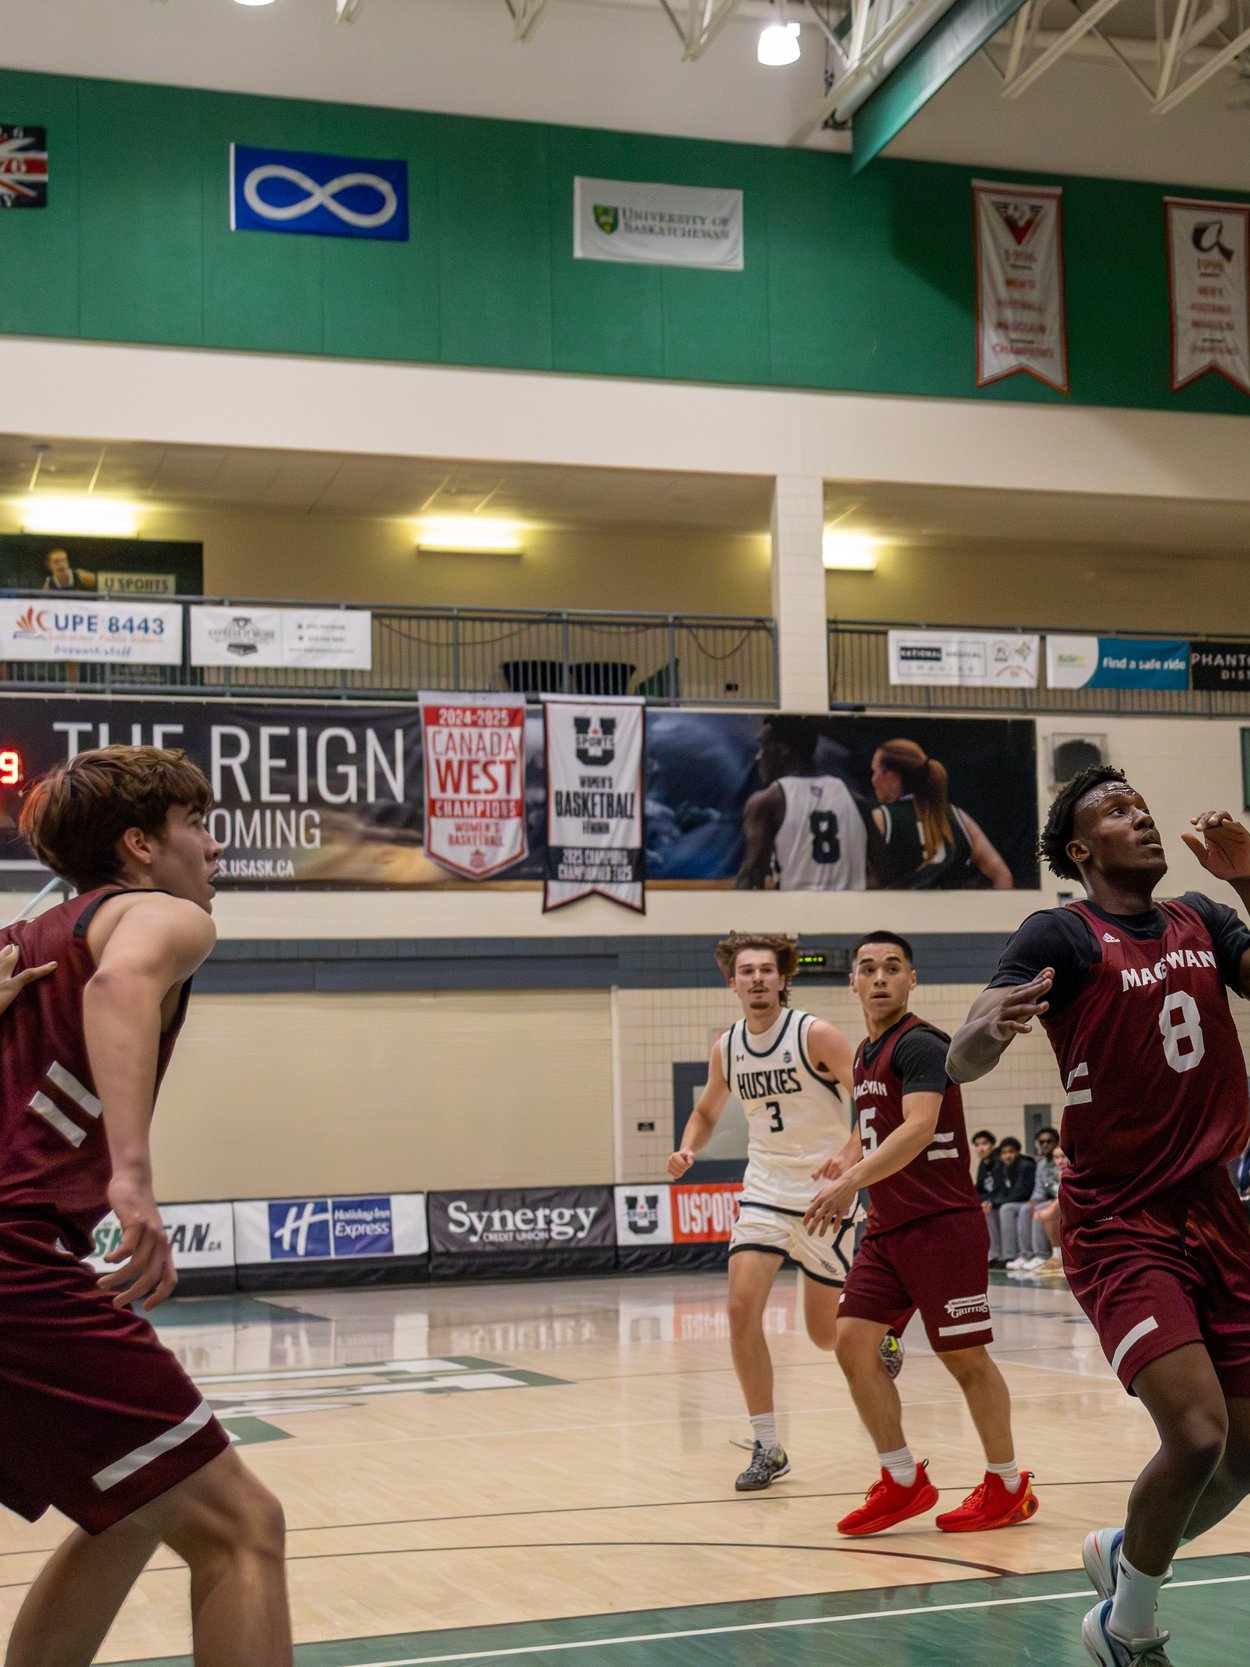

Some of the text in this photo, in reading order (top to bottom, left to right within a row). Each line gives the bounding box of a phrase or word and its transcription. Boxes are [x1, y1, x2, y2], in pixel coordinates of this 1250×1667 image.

[622, 207, 730, 227] UNIVERSITY OF
[623, 222, 729, 239] SASKATCHEWAN
[118, 579, 169, 592] SPORTS
[107, 616, 165, 635] 8443
[1103, 658, 1127, 670] Find
[1138, 658, 1162, 670] safe
[1163, 658, 1186, 670] ride
[439, 709, 509, 725] 2024-2025
[432, 730, 518, 757] CANADA
[211, 726, 404, 804] REIGN
[435, 759, 516, 795] WEST
[435, 801, 516, 817] CHAMPIONS
[555, 791, 635, 819] BASKETBALL
[204, 808, 322, 849] OMING
[809, 810, 840, 864] 8
[215, 858, 295, 878] S.USASK.CA
[1159, 990, 1206, 1073] 8
[737, 1068, 802, 1100] HUSKIES
[766, 1102, 785, 1133] 3
[860, 1107, 878, 1160] 5
[335, 1221, 390, 1239] Express
[447, 1200, 598, 1242] Synergy
[483, 1231, 549, 1243] CREDIT UNION
